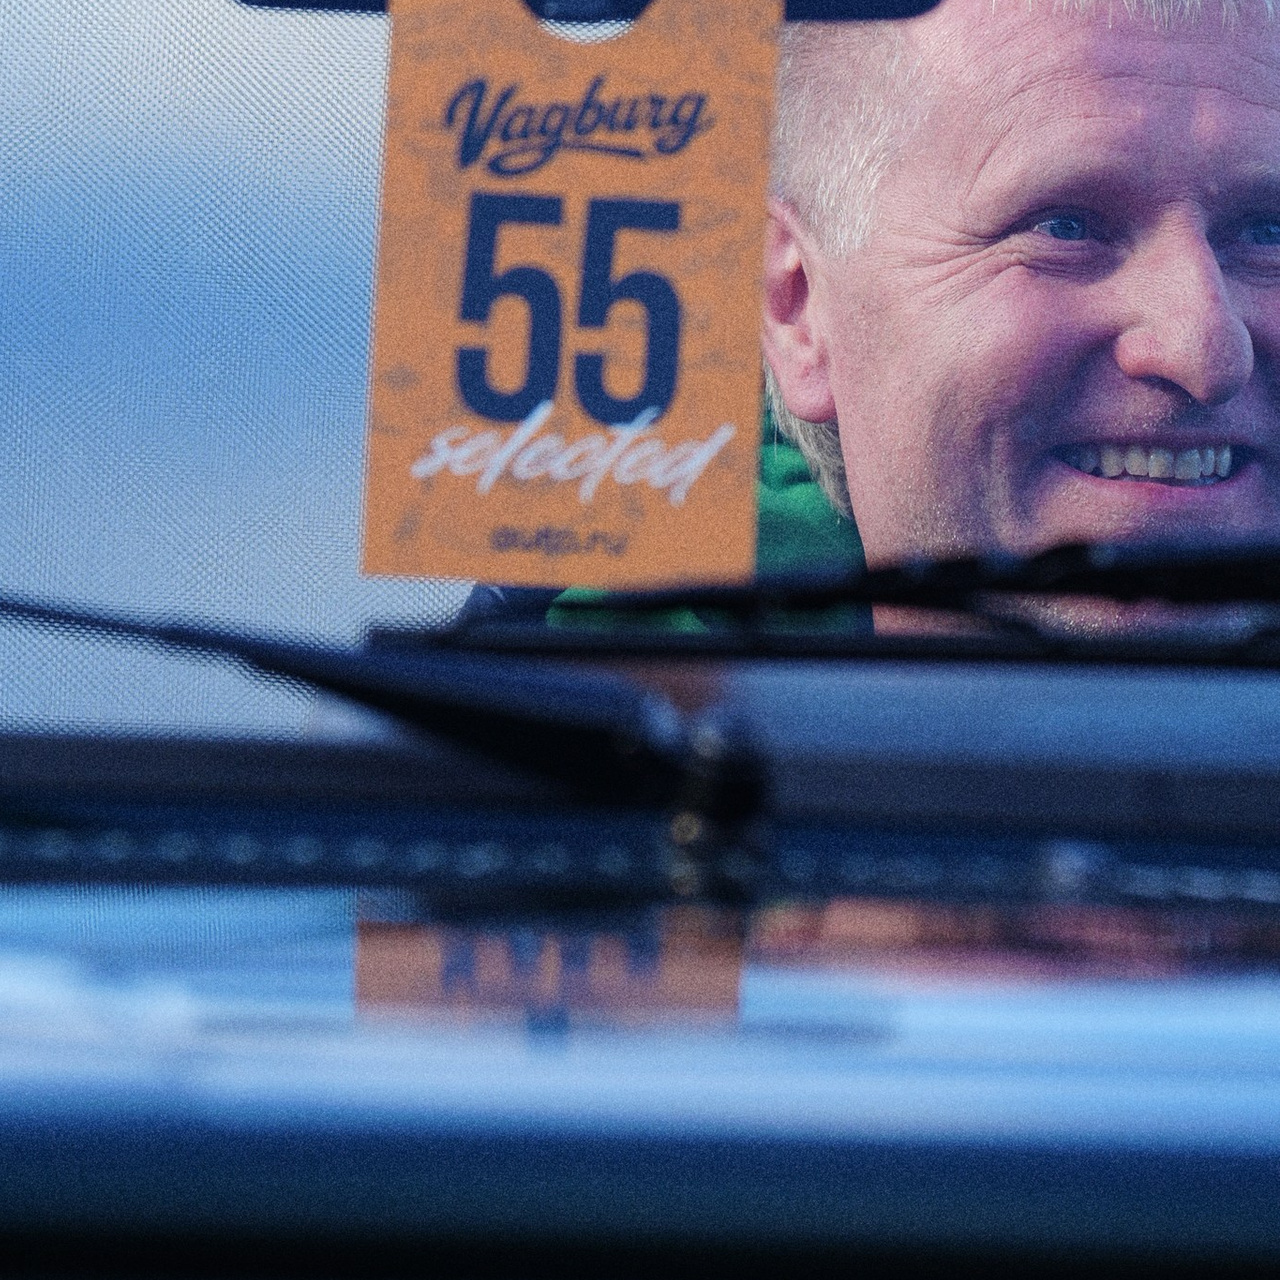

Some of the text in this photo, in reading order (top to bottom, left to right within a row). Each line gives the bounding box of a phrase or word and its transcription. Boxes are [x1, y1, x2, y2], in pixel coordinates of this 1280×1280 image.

[444, 74, 708, 176] Vagburg
[455, 192, 681, 426] 55
[411, 400, 736, 507] selected
